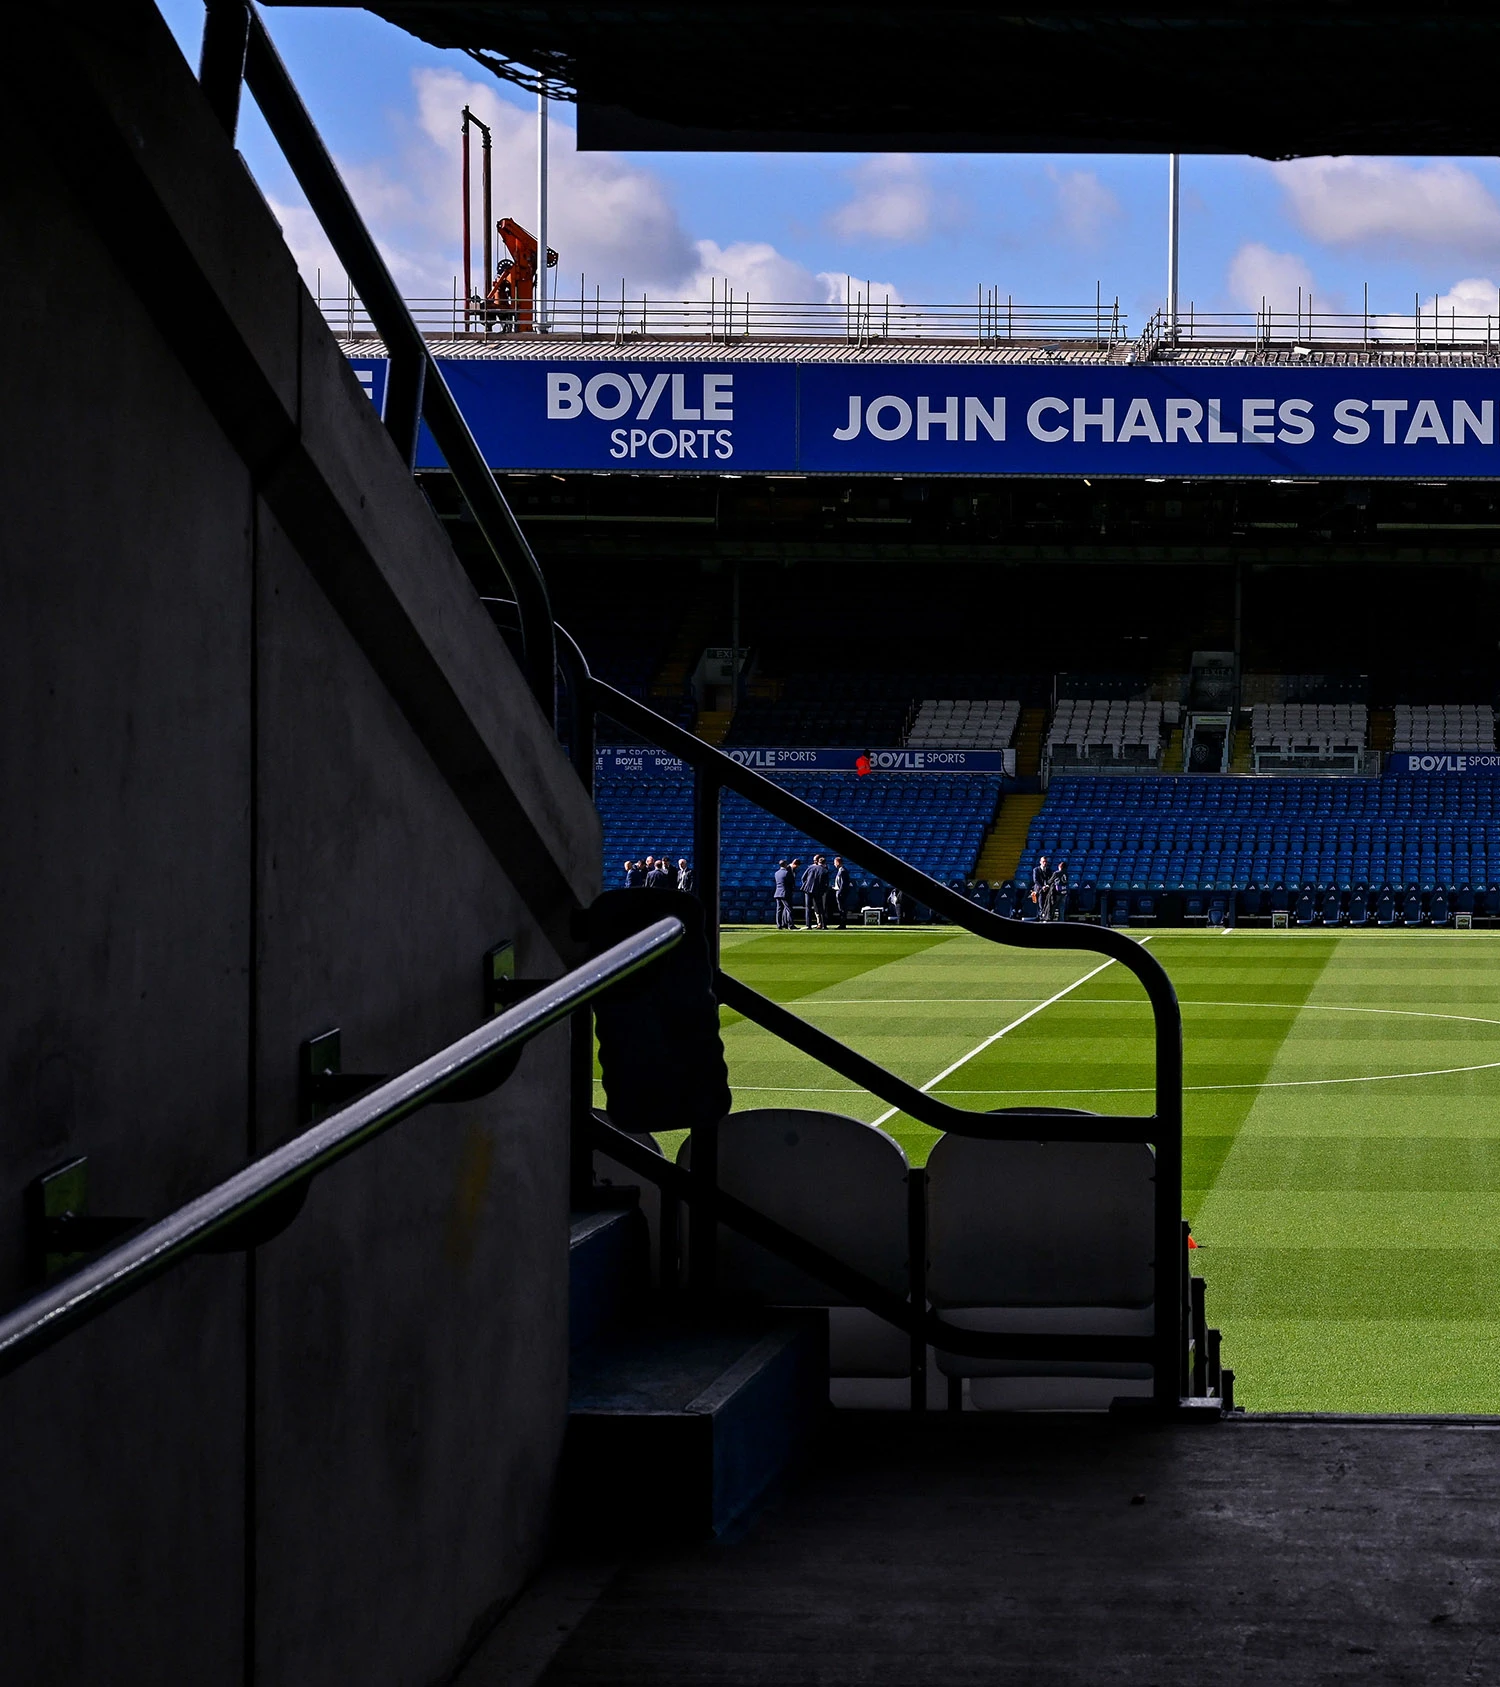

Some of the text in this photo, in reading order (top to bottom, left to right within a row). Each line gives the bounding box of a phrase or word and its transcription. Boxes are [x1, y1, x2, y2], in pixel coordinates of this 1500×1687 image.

[547, 373, 733, 420] BOYLE
[833, 396, 1006, 442] JOHN
[1027, 396, 1315, 445] CHARLES
[610, 429, 733, 459] SPORTS
[716, 650, 733, 658] EXI
[616, 758, 643, 766] BOYLE
[655, 758, 683, 766] BOYLE
[778, 751, 817, 762] SPORTS
[870, 752, 966, 768] BOYLE SPORTS
[1409, 755, 1467, 771] BOYLE
